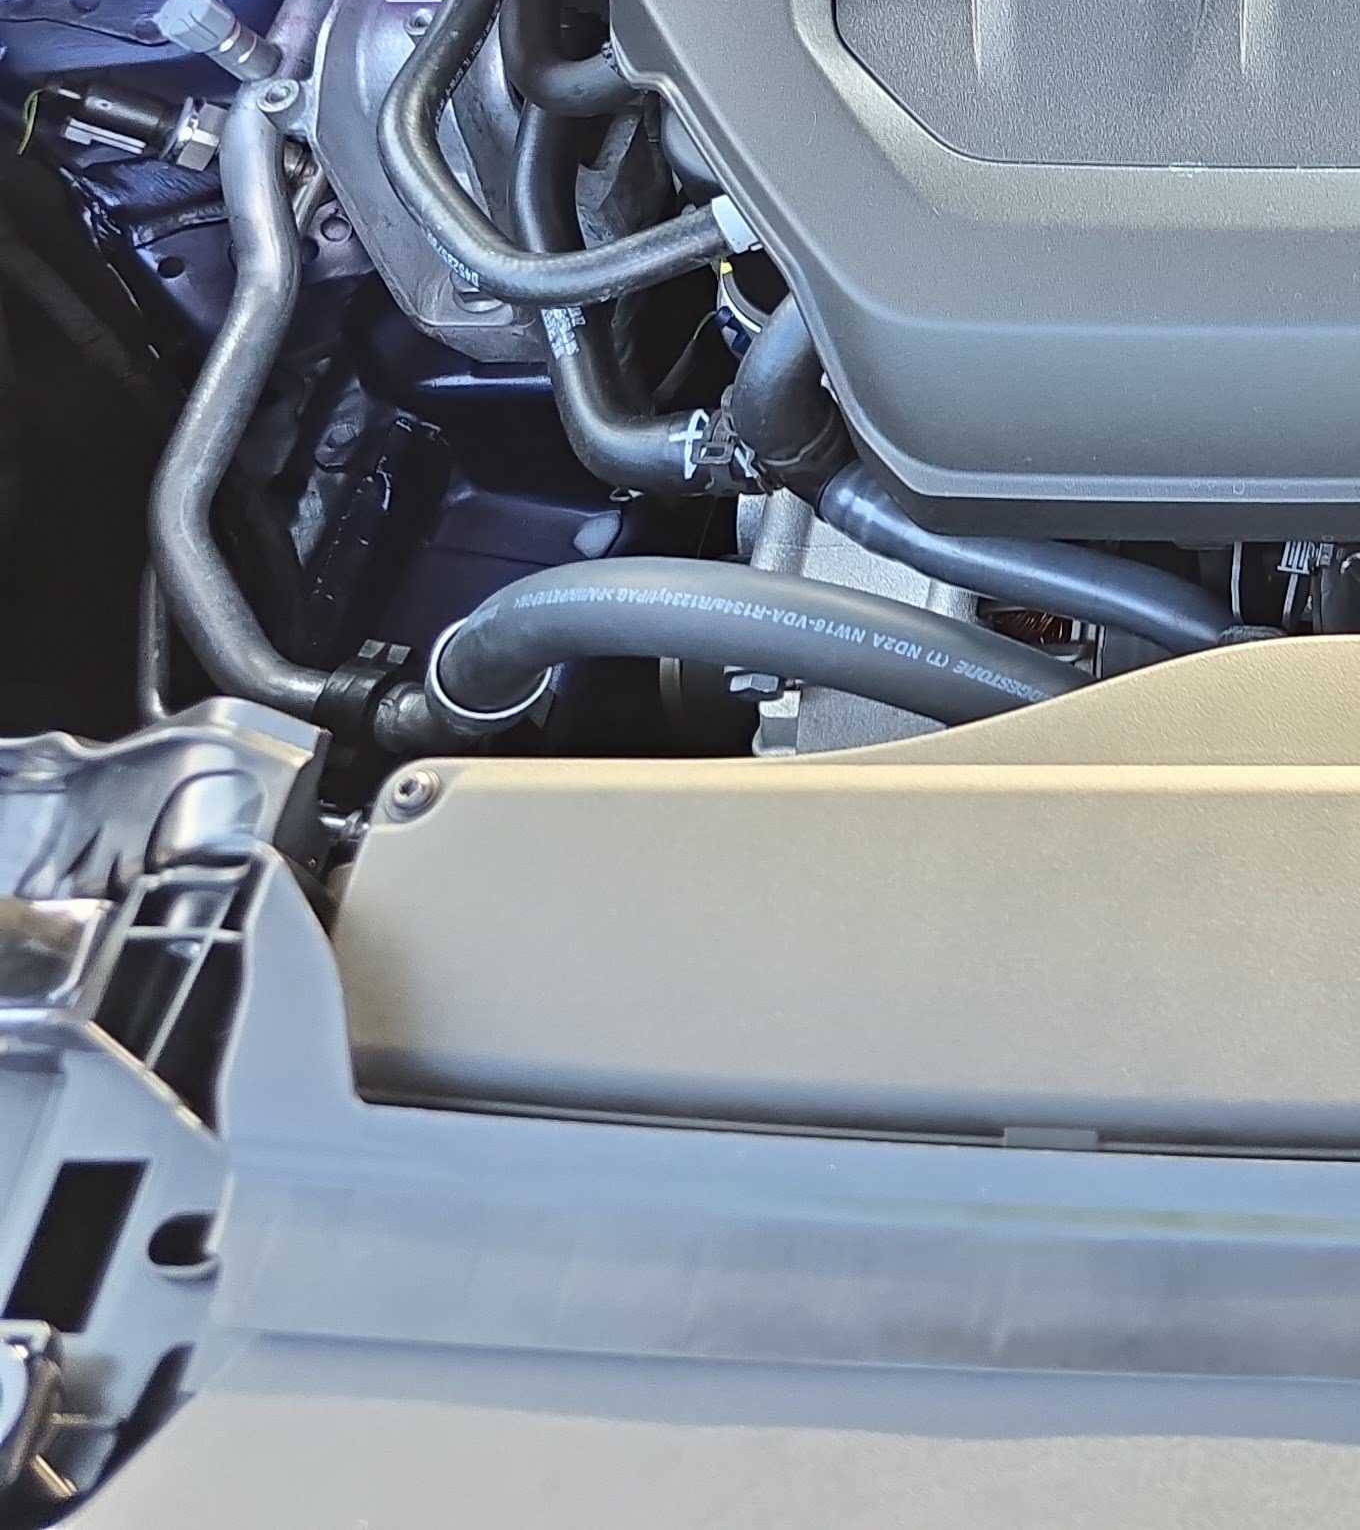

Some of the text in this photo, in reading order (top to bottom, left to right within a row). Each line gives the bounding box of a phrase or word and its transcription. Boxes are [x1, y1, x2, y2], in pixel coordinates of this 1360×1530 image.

[872, 631, 922, 660] ND2A
[925, 649, 951, 669] (T)
[953, 659, 1051, 702] DGESTONE
